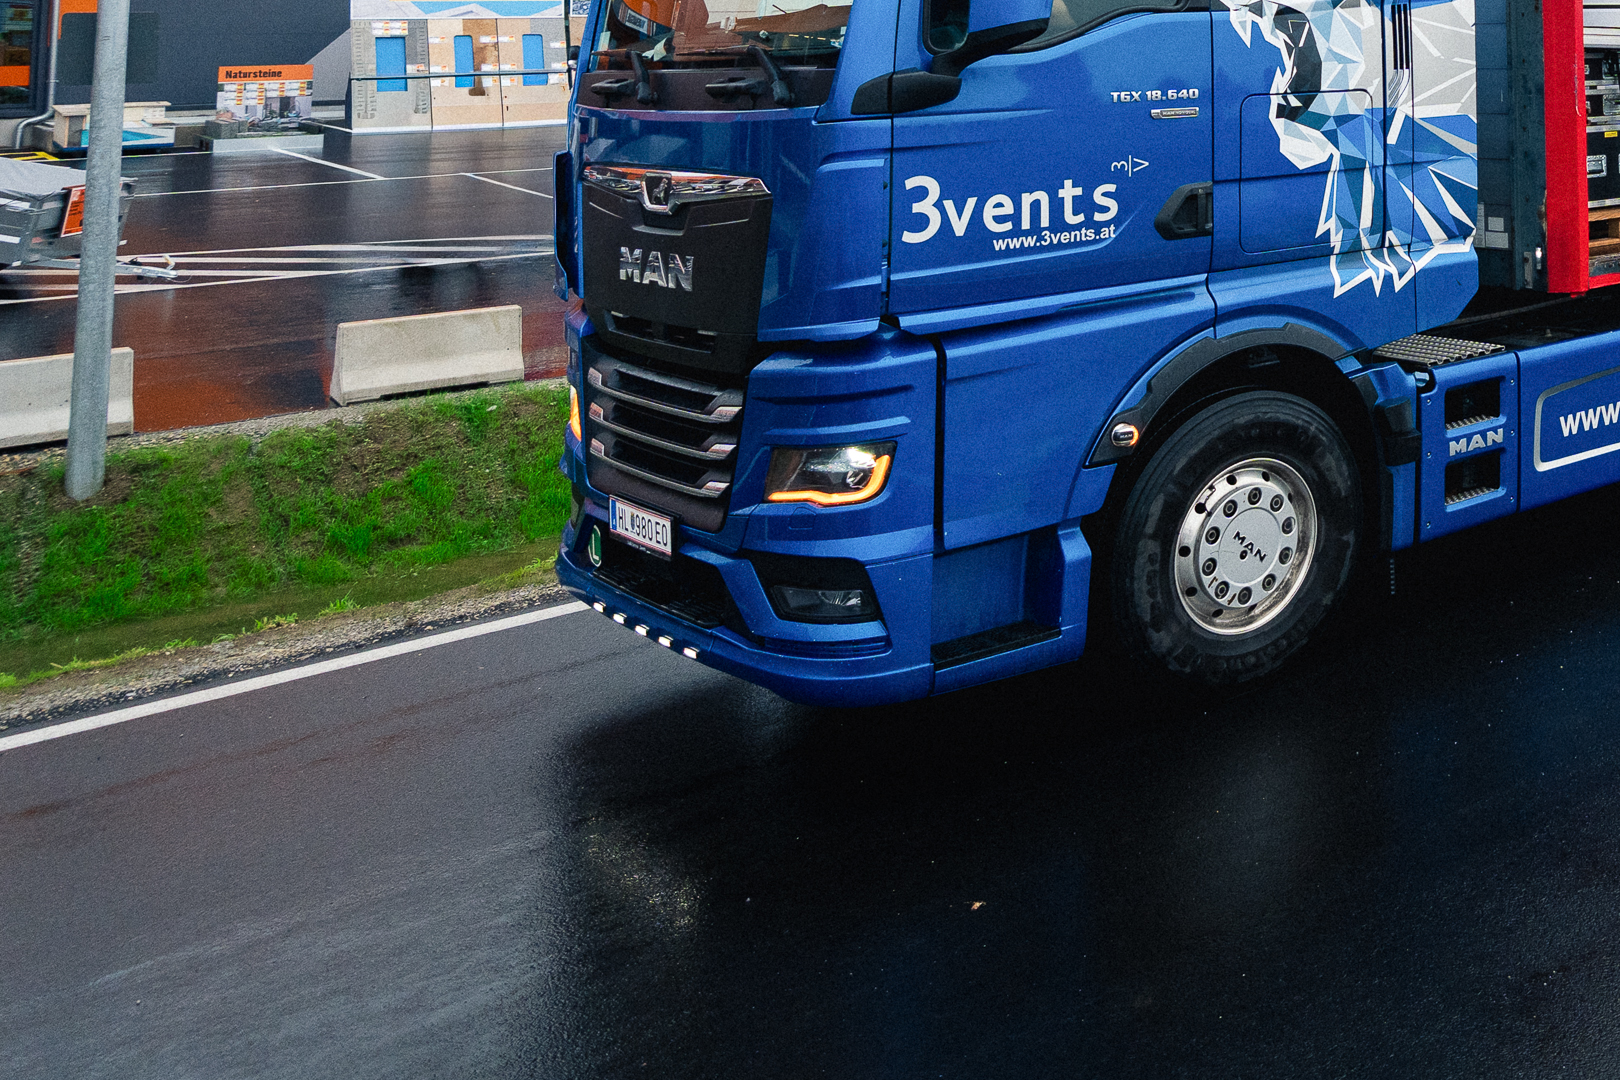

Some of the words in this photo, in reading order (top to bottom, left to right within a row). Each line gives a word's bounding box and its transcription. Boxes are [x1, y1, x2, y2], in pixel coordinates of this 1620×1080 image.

[225, 69, 282, 79] Natursteine
[1110, 90, 1142, 103] TGX
[1146, 88, 1199, 101] 18.640
[901, 174, 1119, 244] 3vents
[992, 223, 1116, 251] www.3vents.at
[619, 246, 694, 292] MAN
[1448, 428, 1504, 457] MAN
[618, 506, 629, 532] HL
[636, 513, 653, 542] 980
[1233, 530, 1267, 563] MAN
